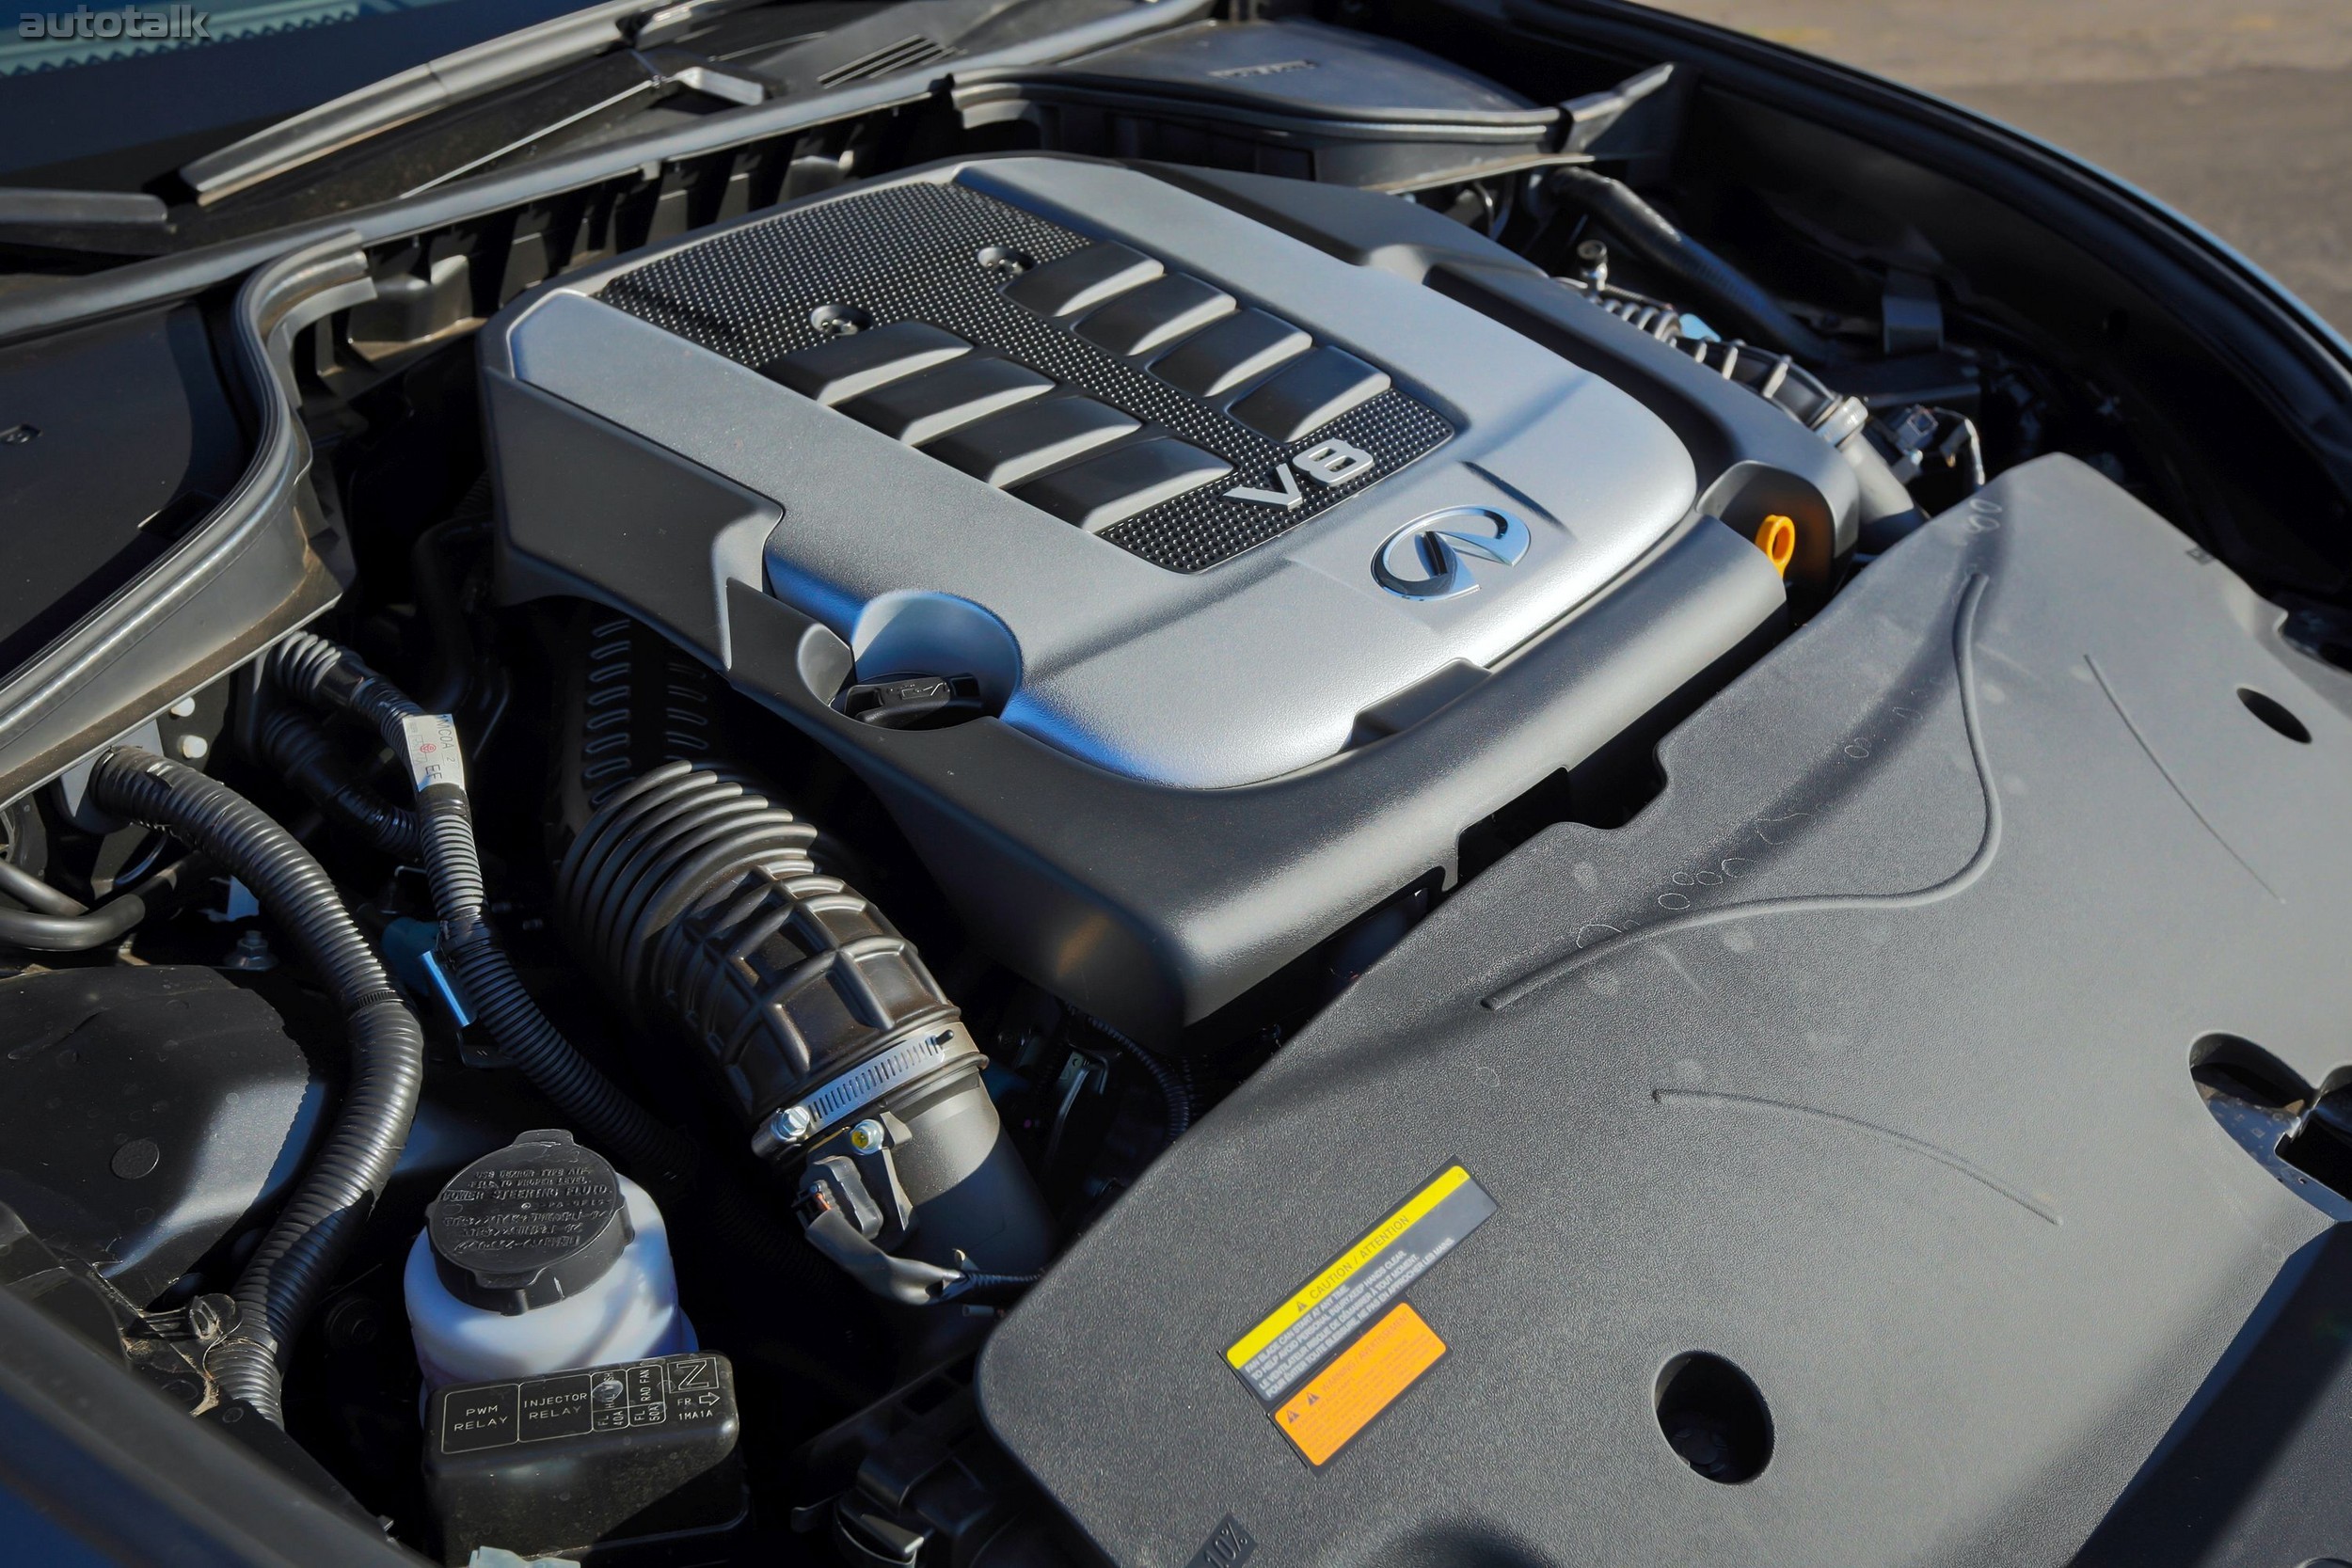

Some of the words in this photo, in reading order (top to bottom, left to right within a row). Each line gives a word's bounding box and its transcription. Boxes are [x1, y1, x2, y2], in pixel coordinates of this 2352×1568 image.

[1223, 437, 1375, 512] V8
[501, 1180, 513, 1188] TO
[442, 1189, 485, 1201] POWER
[493, 1187, 559, 1201] STEERING
[1308, 1260, 1353, 1300] CAUTION
[1358, 1214, 1410, 1259] ATTENTION
[1250, 1368, 1263, 1381] TO
[1260, 1354, 1280, 1372] HELP
[1276, 1338, 1299, 1359] AVOID
[1295, 1311, 1331, 1343] PERSONAL
[1362, 1264, 1387, 1287] HANDS
[1257, 1339, 1280, 1362] BLADE
[1277, 1329, 1295, 1345] CAN
[1291, 1312, 1313, 1334] START
[1310, 1306, 1322, 1318] AT
[1317, 1295, 1334, 1311] ANY
[1264, 1377, 1286, 1397] POUR
[1304, 1342, 1327, 1364] TOUTE
[1364, 1297, 1381, 1312] PAS
[1386, 1260, 1425, 1294] APPROCHER
[1421, 1251, 1436, 1265] LES
[1258, 1377, 1270, 1390] LE
[1265, 1344, 1310, 1383] VENTILATEUR
[1327, 1318, 1341, 1330] DE
[1374, 1274, 1393, 1291] TOUT
[640, 1369, 650, 1384] FAN
[524, 1392, 588, 1408] INJECTOR
[641, 1386, 652, 1402] RAD
[677, 1397, 691, 1406] FR
[466, 1404, 498, 1417] PWM
[529, 1405, 581, 1419] RELAY
[613, 1411, 624, 1426] 40A
[634, 1410, 645, 1421] FL
[649, 1405, 660, 1421] 50A
[678, 1409, 713, 1421] 1MA1A
[453, 1416, 508, 1432] RELAY
